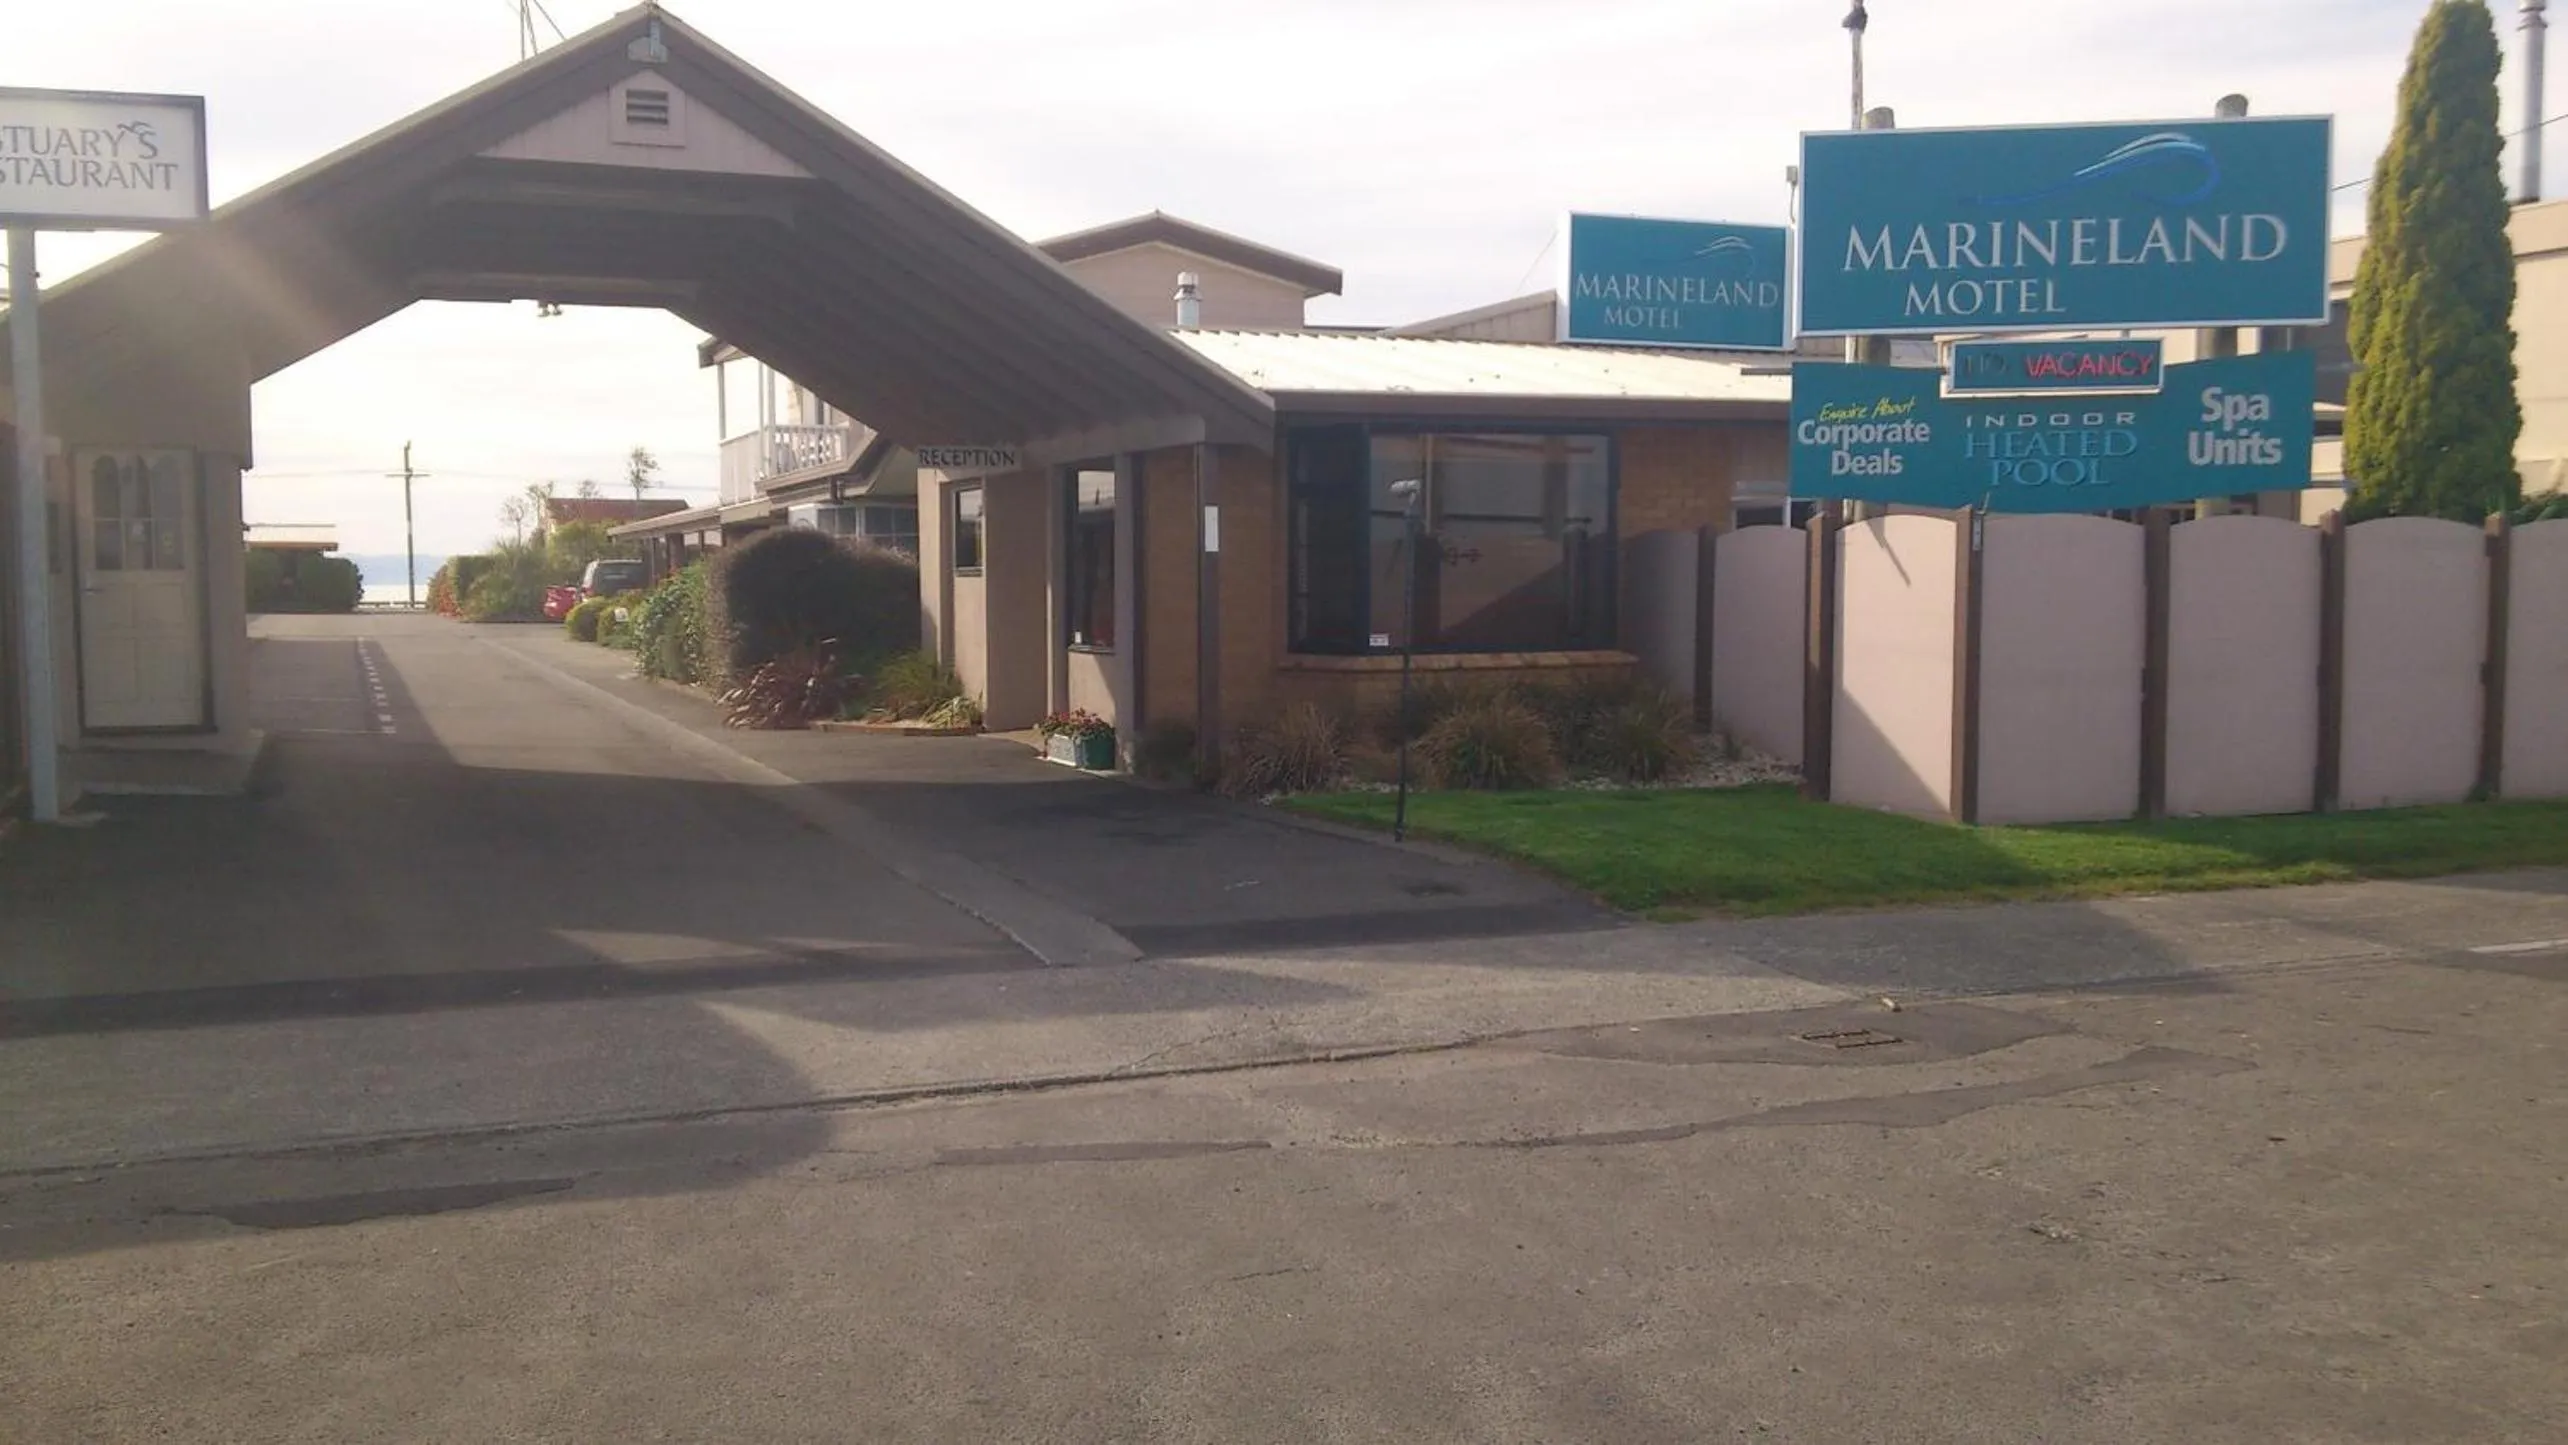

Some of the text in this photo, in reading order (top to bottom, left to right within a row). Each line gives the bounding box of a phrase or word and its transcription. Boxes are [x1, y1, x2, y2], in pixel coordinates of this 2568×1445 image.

[0, 121, 158, 159] TUARY'S
[1843, 214, 2288, 271] MARINELAND
[1575, 273, 1779, 308] MARINELAND
[1904, 277, 2067, 317] MOTEL
[1604, 305, 1683, 329] MOTEL
[2025, 352, 2153, 378] VACANCY
[1871, 396, 1916, 419] About
[1966, 412, 2137, 428] INDOOR
[2201, 386, 2270, 431] Spa
[1797, 419, 1931, 451] Corporate
[1965, 429, 2138, 458] HEATED
[2189, 428, 2283, 466] Units
[918, 449, 1015, 467] RECEPTION
[1831, 448, 1904, 475] Deals
[1991, 458, 2110, 486] POOL
